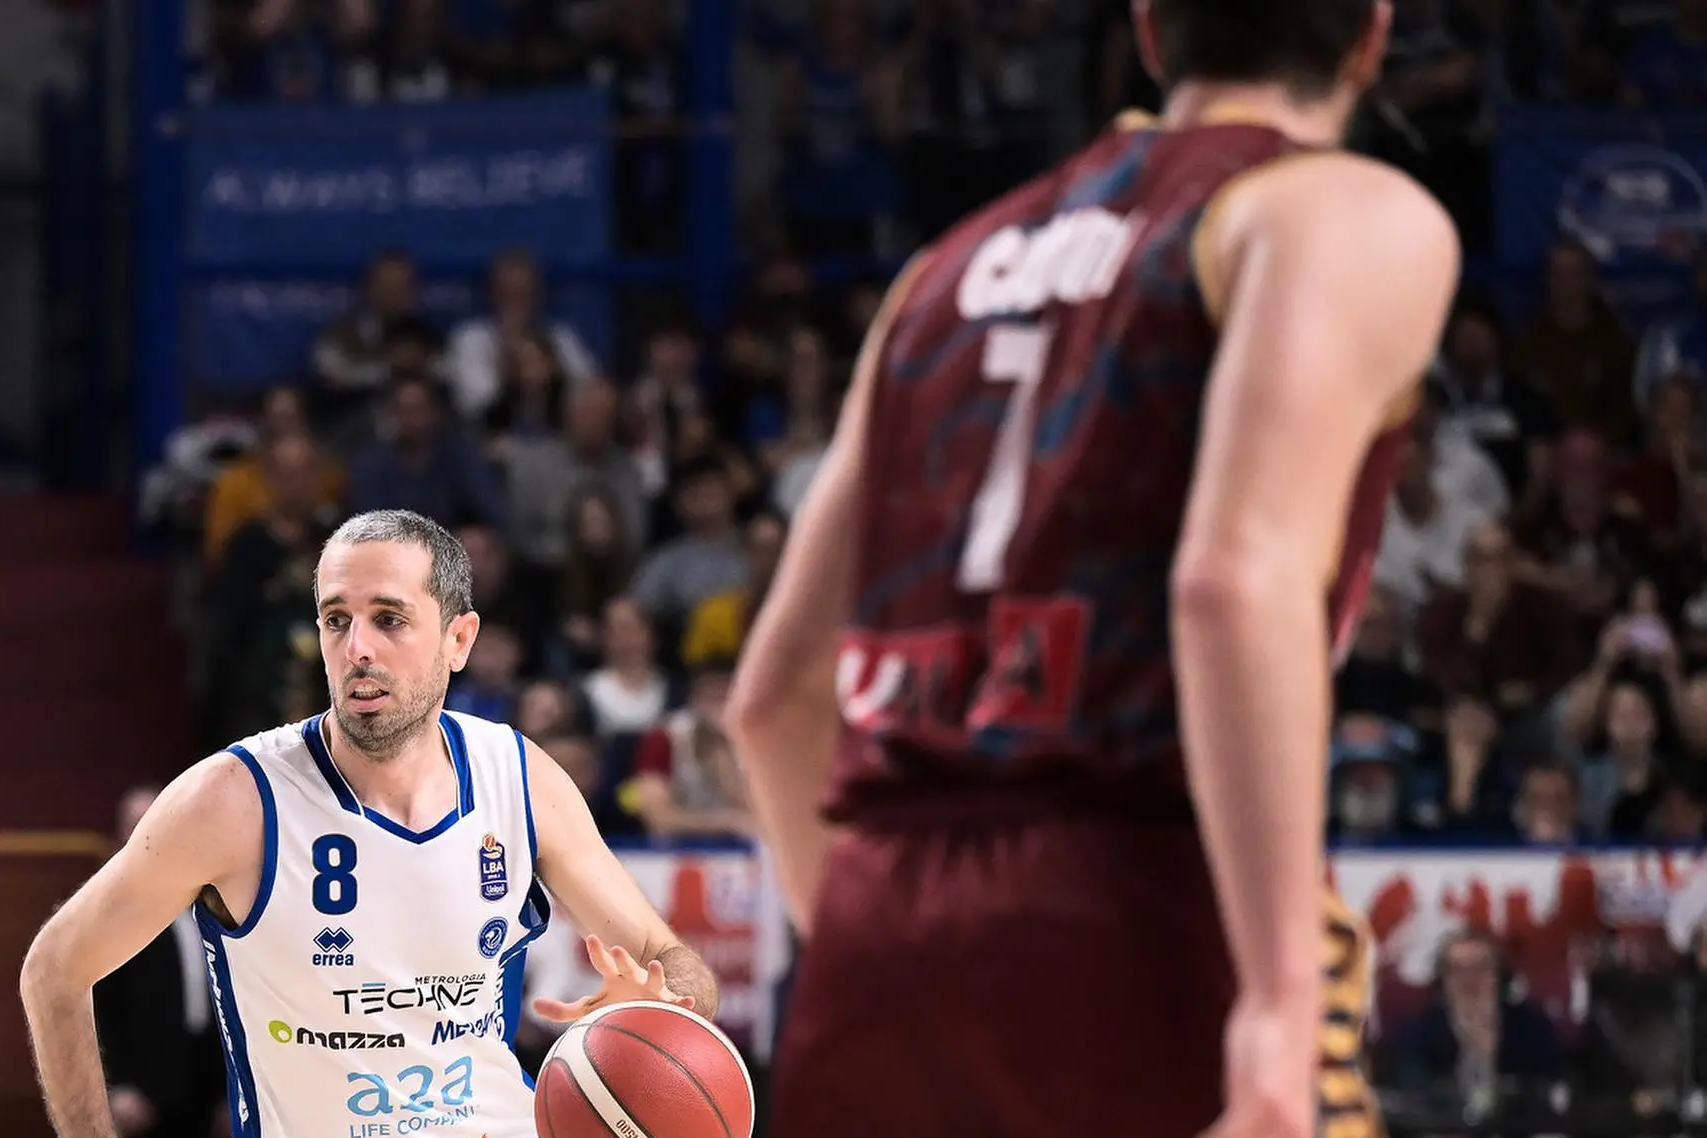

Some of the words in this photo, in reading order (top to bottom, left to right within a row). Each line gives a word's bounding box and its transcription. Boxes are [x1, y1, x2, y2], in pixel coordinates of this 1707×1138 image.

[953, 324, 1051, 592] 7
[312, 833, 358, 916] 8
[483, 861, 505, 874] LBA
[312, 953, 355, 967] errea
[414, 973, 487, 986] METROLOGIA
[332, 980, 485, 1016] TECHNE
[296, 1026, 406, 1051] mazza
[346, 1055, 473, 1117] a2a
